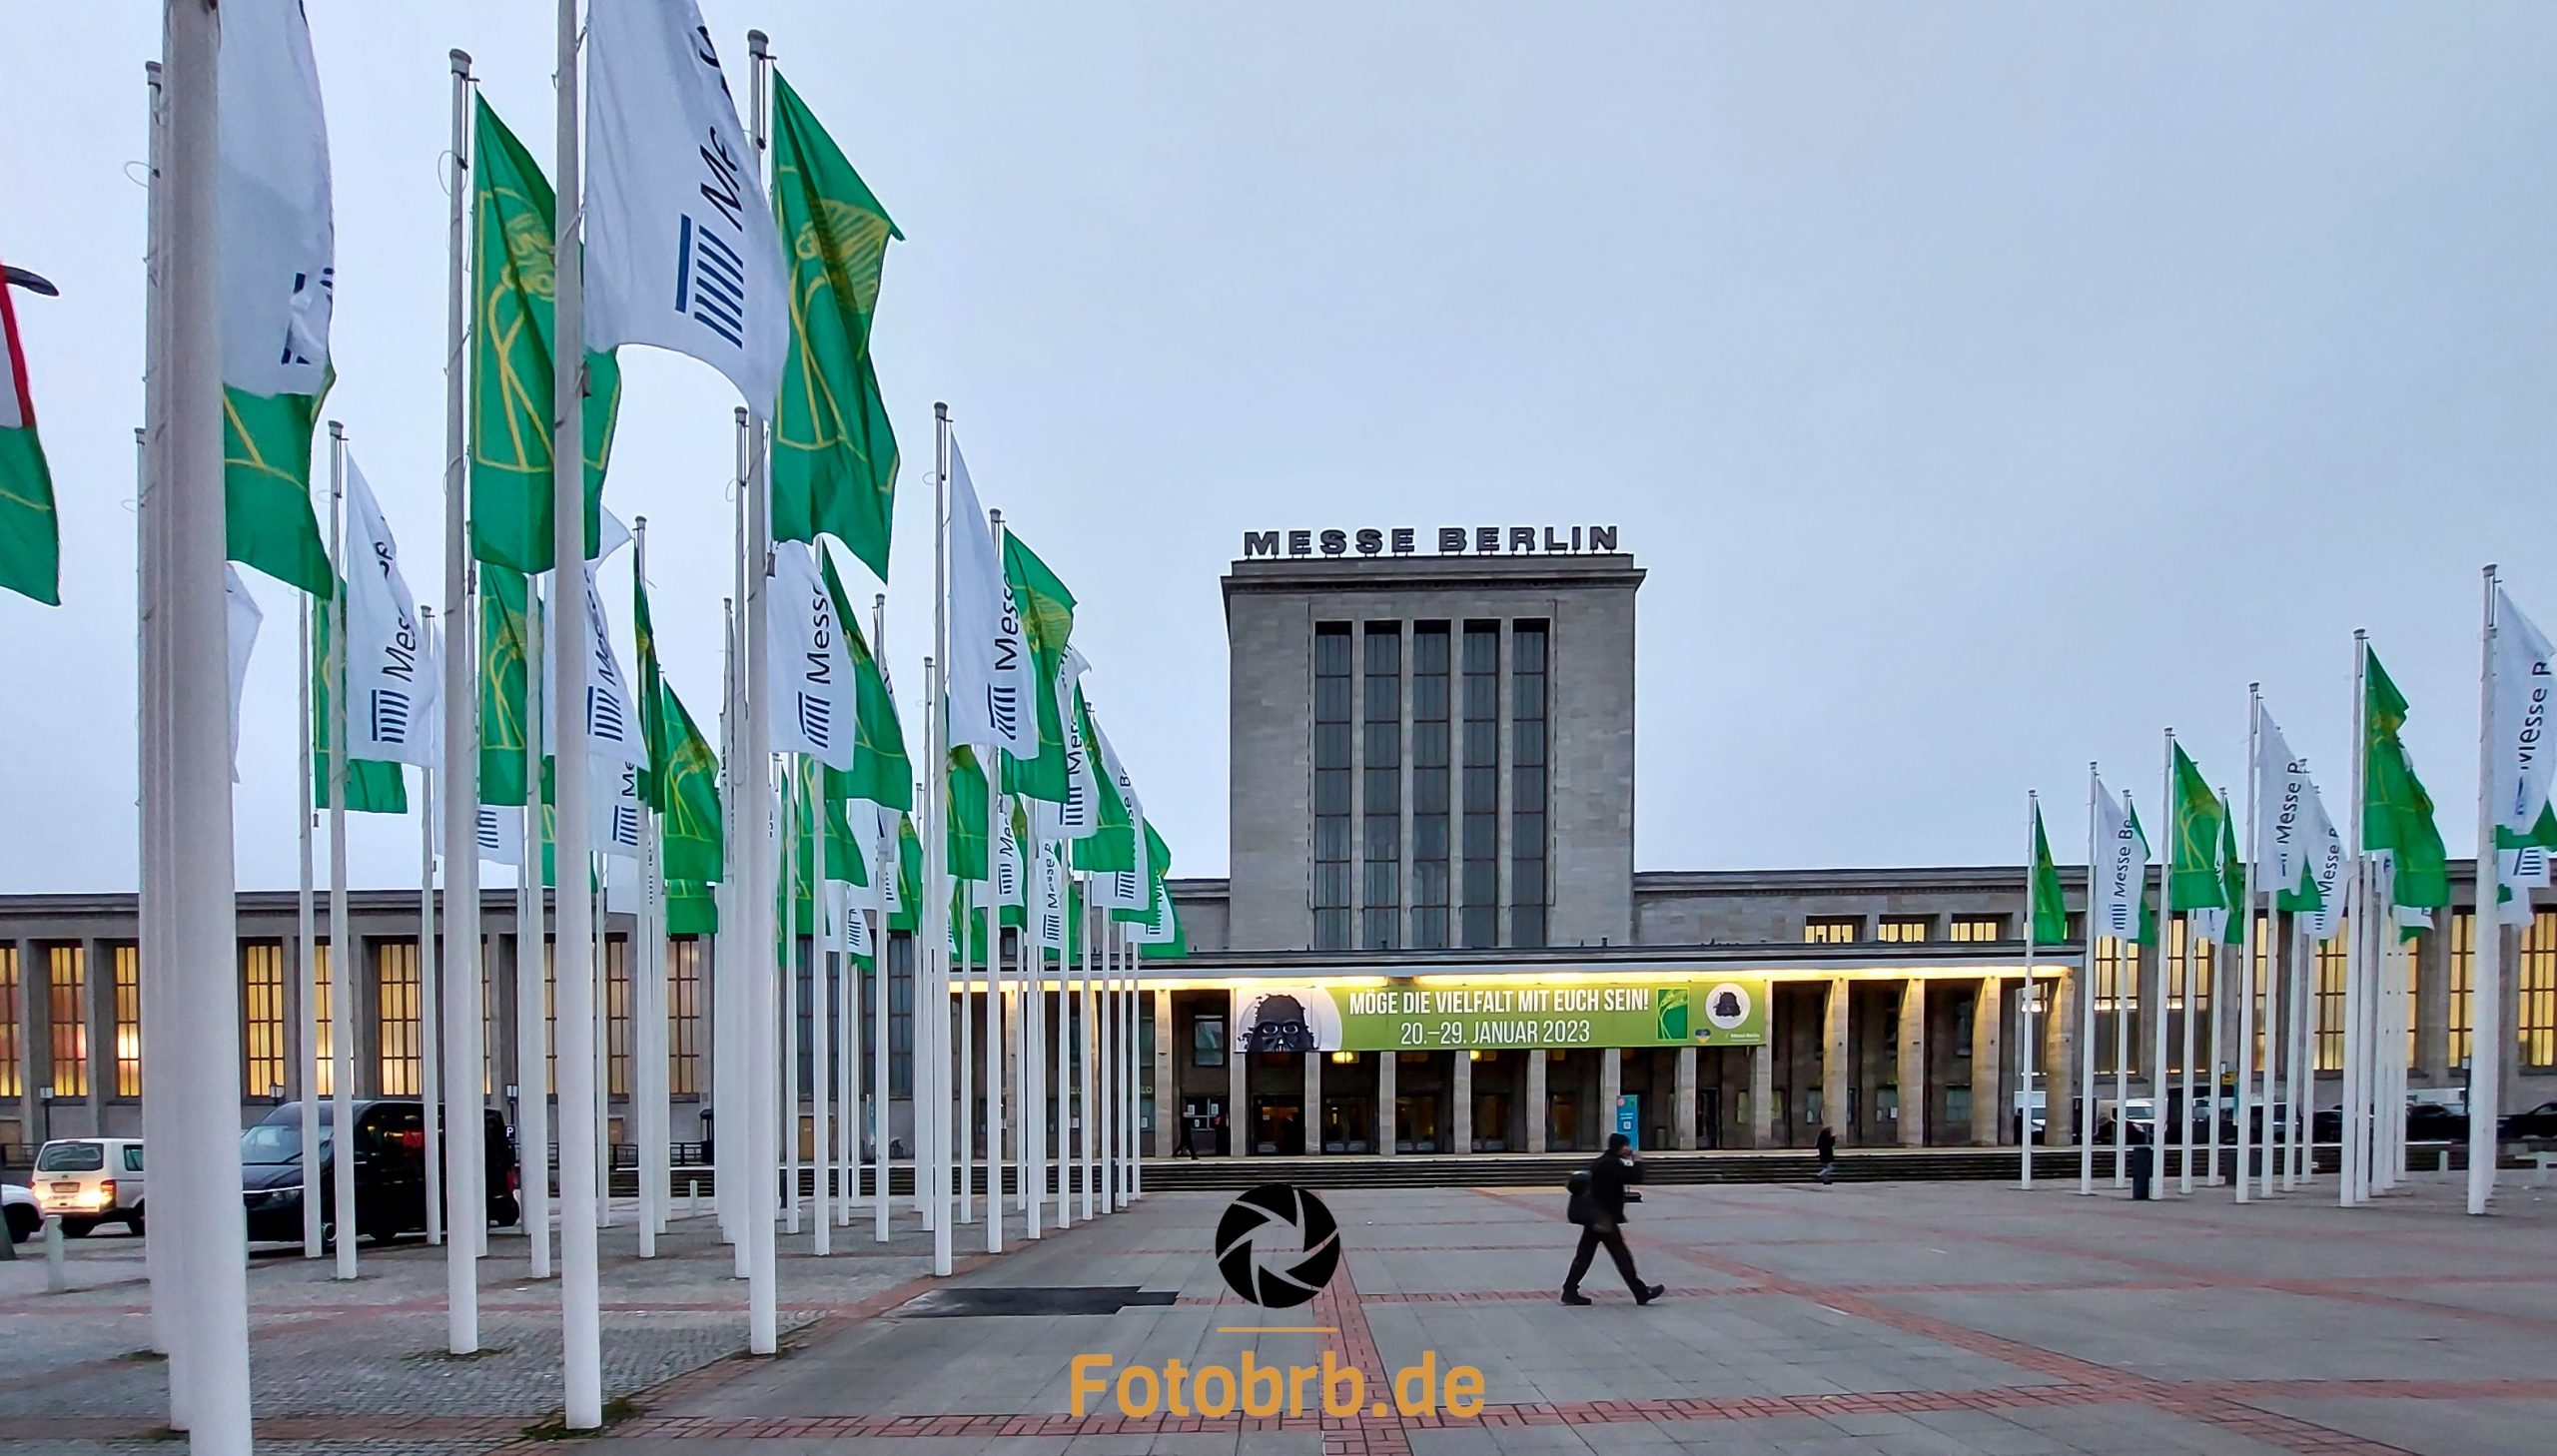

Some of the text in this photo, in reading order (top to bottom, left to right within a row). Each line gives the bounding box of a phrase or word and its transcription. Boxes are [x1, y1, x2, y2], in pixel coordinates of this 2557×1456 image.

[1244, 526, 1617, 556] MESSE BERLIN
[2114, 847, 2131, 898] Messe
[1349, 988, 1649, 1015] MÖGE DIE VIELFALT MIT EUCH SEIN!
[1471, 1020, 1539, 1045] JANUAR
[1542, 1019, 1590, 1044] 2023
[505, 1126, 514, 1137] P
